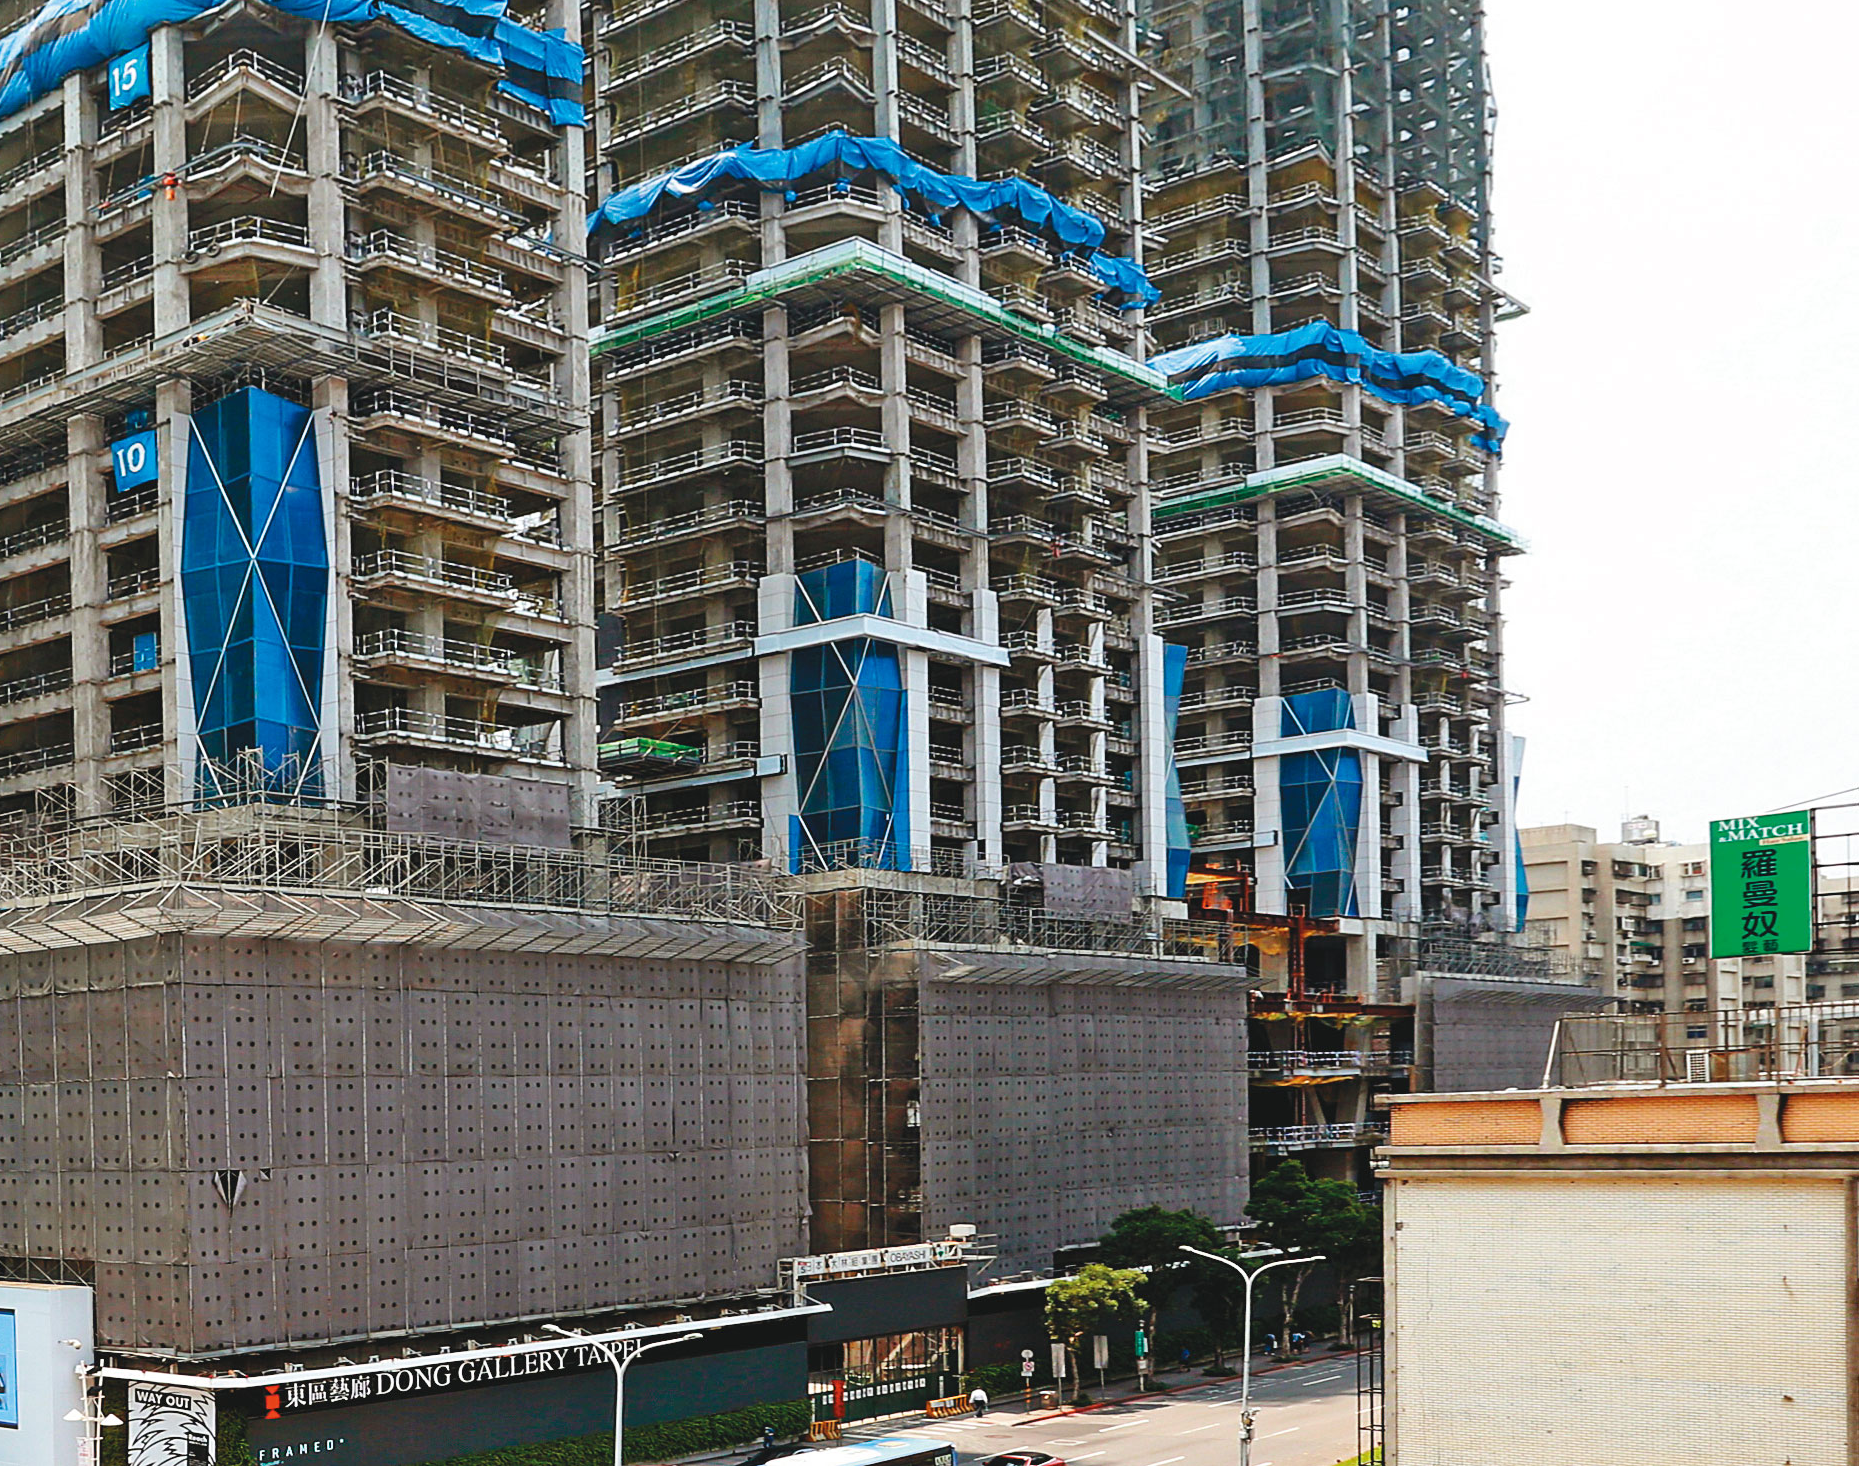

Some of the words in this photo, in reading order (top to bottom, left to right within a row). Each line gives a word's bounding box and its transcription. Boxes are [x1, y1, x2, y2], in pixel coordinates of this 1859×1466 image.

[112, 58, 138, 97] 15
[116, 442, 146, 477] 10
[1718, 817, 1760, 832] MIX
[1718, 823, 1803, 843] &MATCH
[1741, 848, 1779, 939] 羅曼奴
[890, 1250, 926, 1262] OBAYASHI
[285, 1374, 371, 1408] 東區藝廊
[376, 1364, 452, 1395] DONG
[458, 1347, 569, 1383] GALLERY
[574, 1338, 642, 1367] TAIPEI
[136, 1391, 164, 1405] WAY
[167, 1394, 190, 1409] OUT
